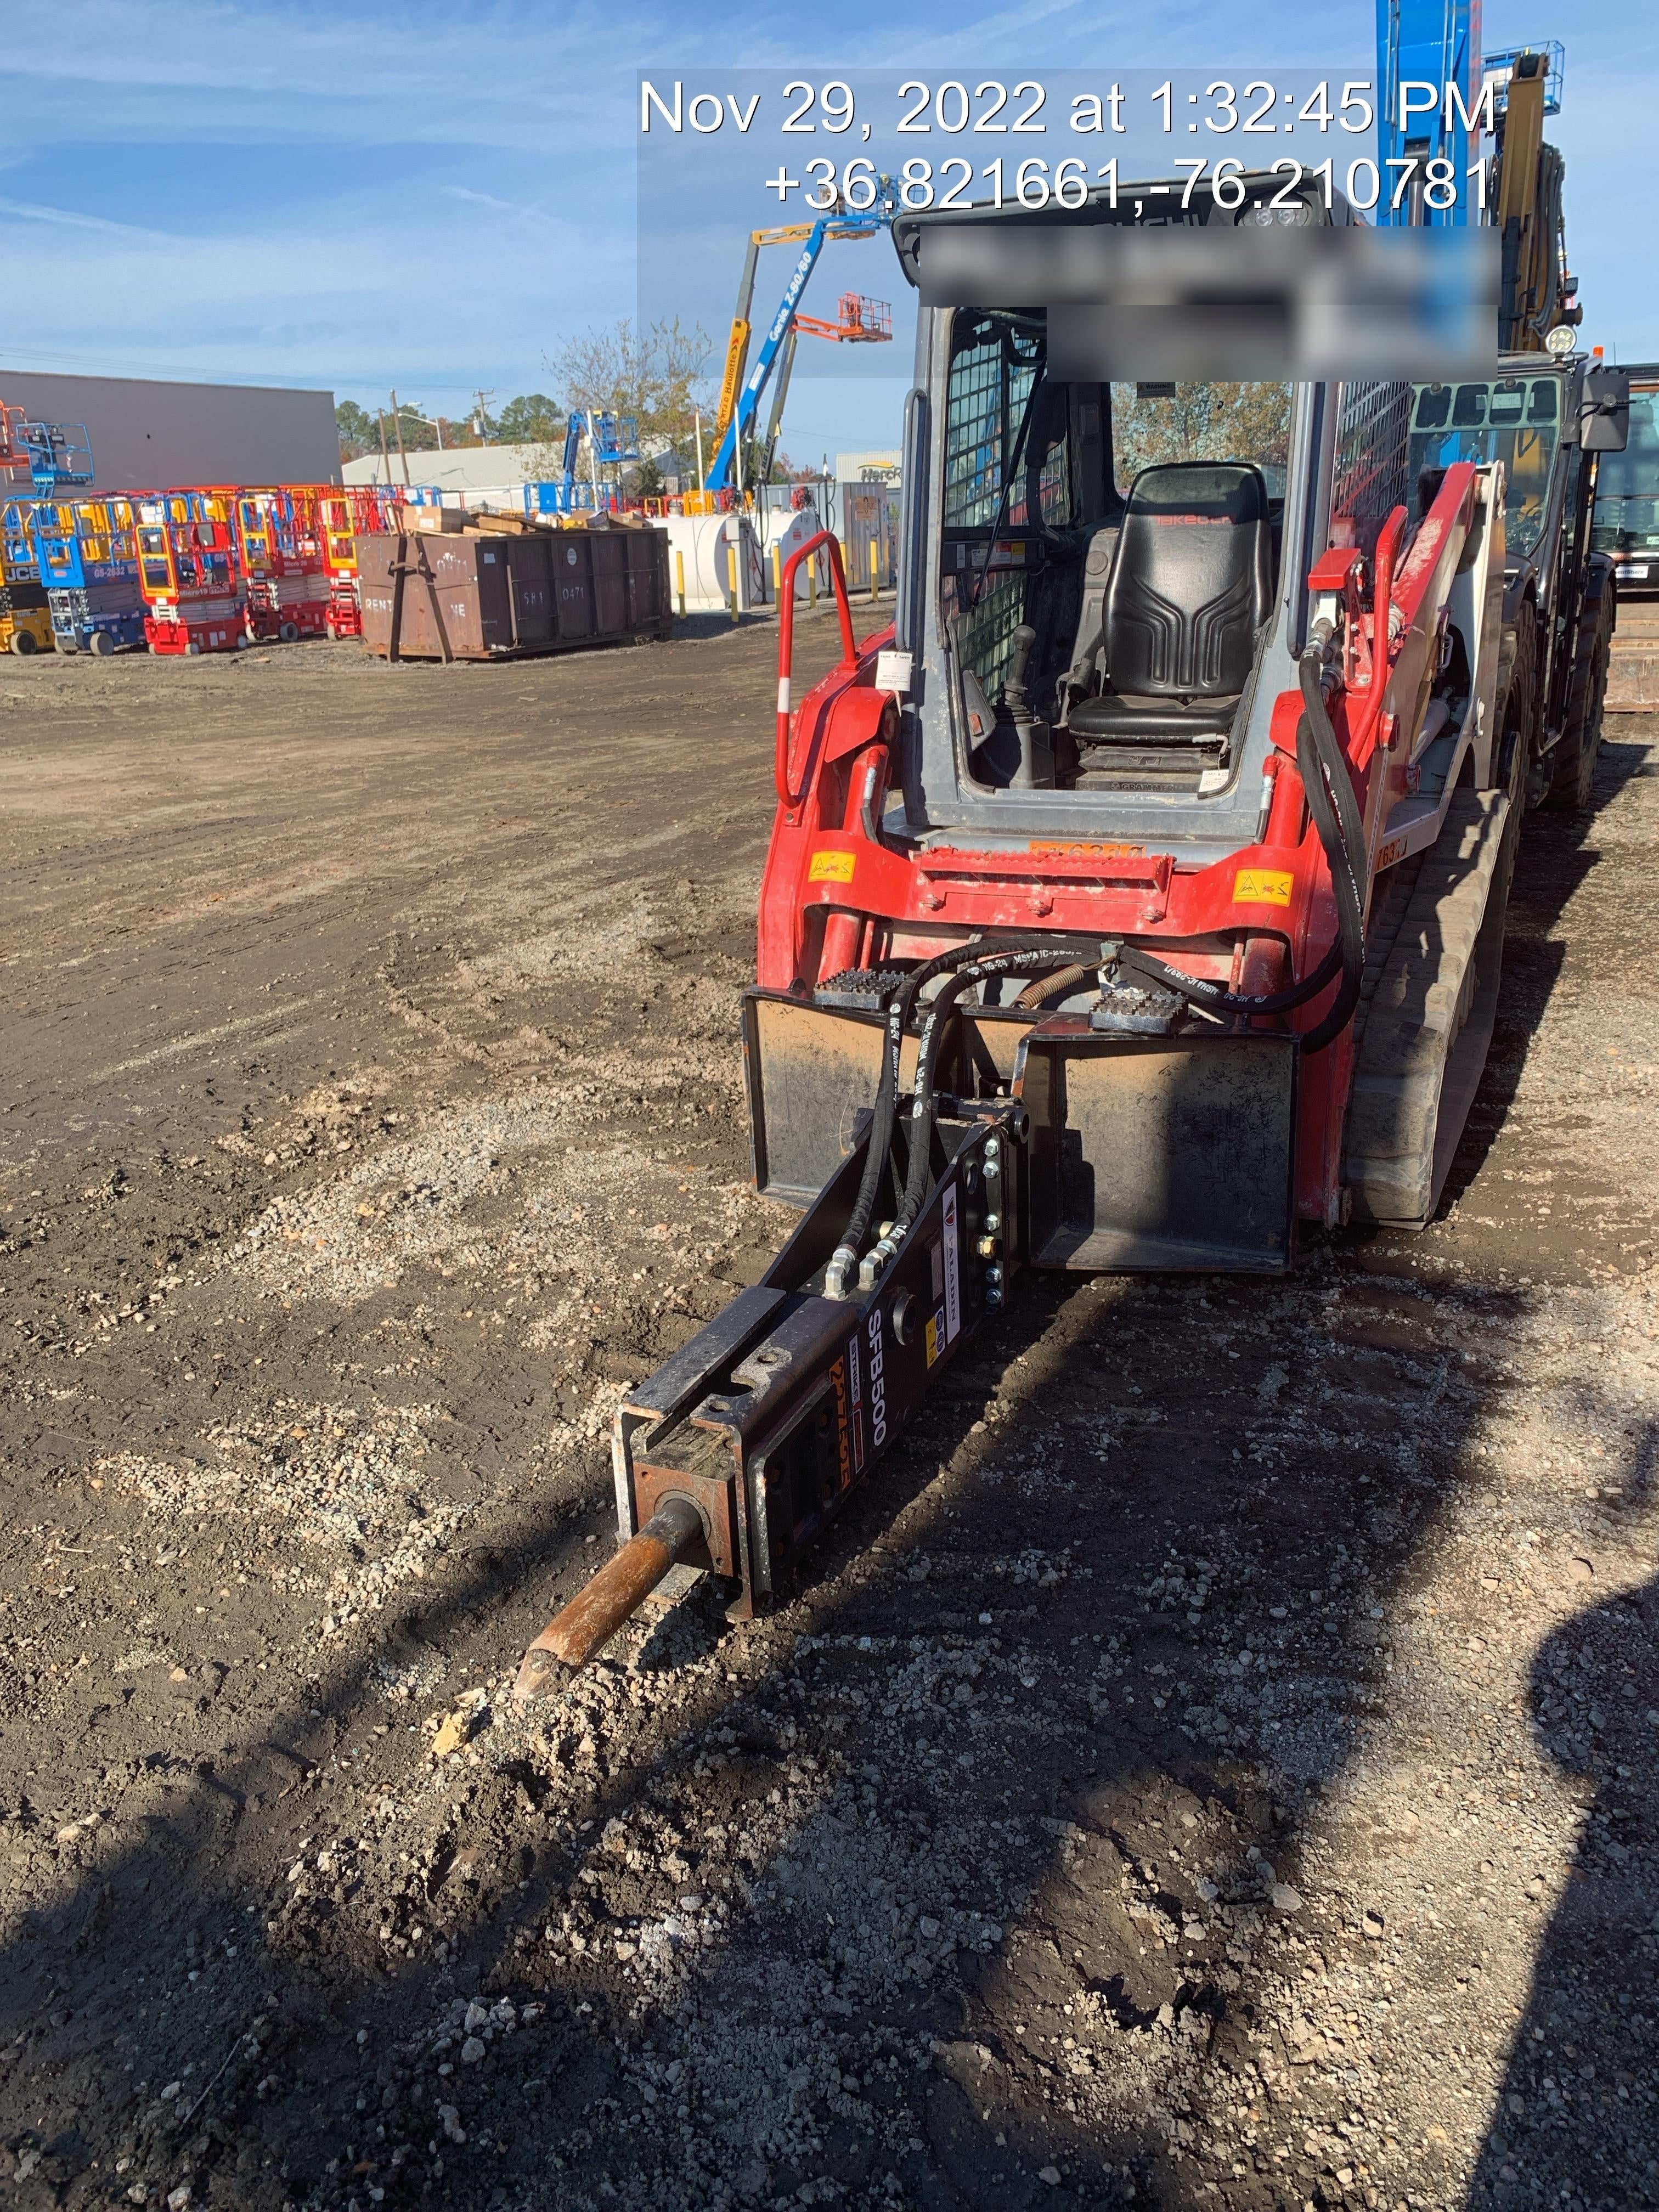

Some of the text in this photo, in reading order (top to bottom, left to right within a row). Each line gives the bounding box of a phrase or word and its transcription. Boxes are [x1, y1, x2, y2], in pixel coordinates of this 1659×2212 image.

[769, 251, 811, 342] Genie Z-80/60
[725, 353, 737, 394] Haulotte
[5, 566, 41, 582] JCB
[94, 565, 126, 579] GS-2632
[365, 598, 393, 612] RENT
[1122, 782, 1174, 792] GRAMMER
[889, 1017, 900, 1042] HG-24
[914, 1066, 926, 1096] HG-24
[947, 1234, 956, 1322] PALADIN
[868, 1308, 887, 1447] SFB500
